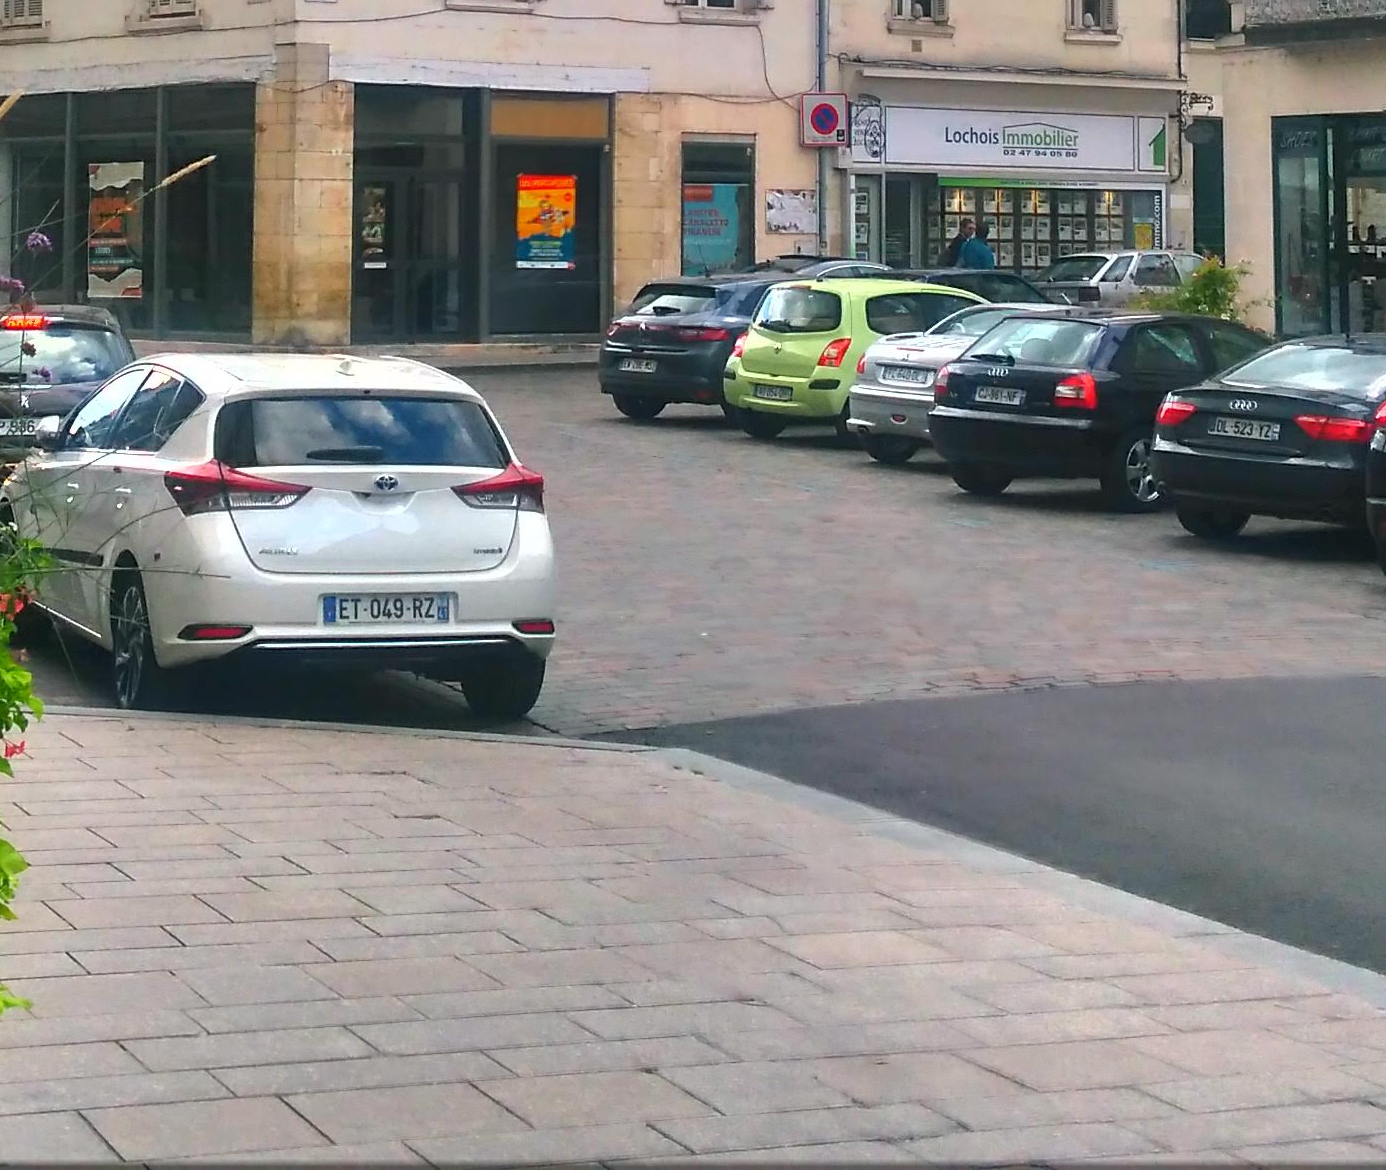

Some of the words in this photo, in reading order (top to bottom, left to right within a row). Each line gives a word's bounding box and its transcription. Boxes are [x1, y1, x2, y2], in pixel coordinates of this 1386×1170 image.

[945, 126, 999, 145] Lochois
[1002, 129, 1079, 147] Immobilier
[1018, 149, 1031, 157] 47
[339, 597, 436, 620] ET-049-RZ
